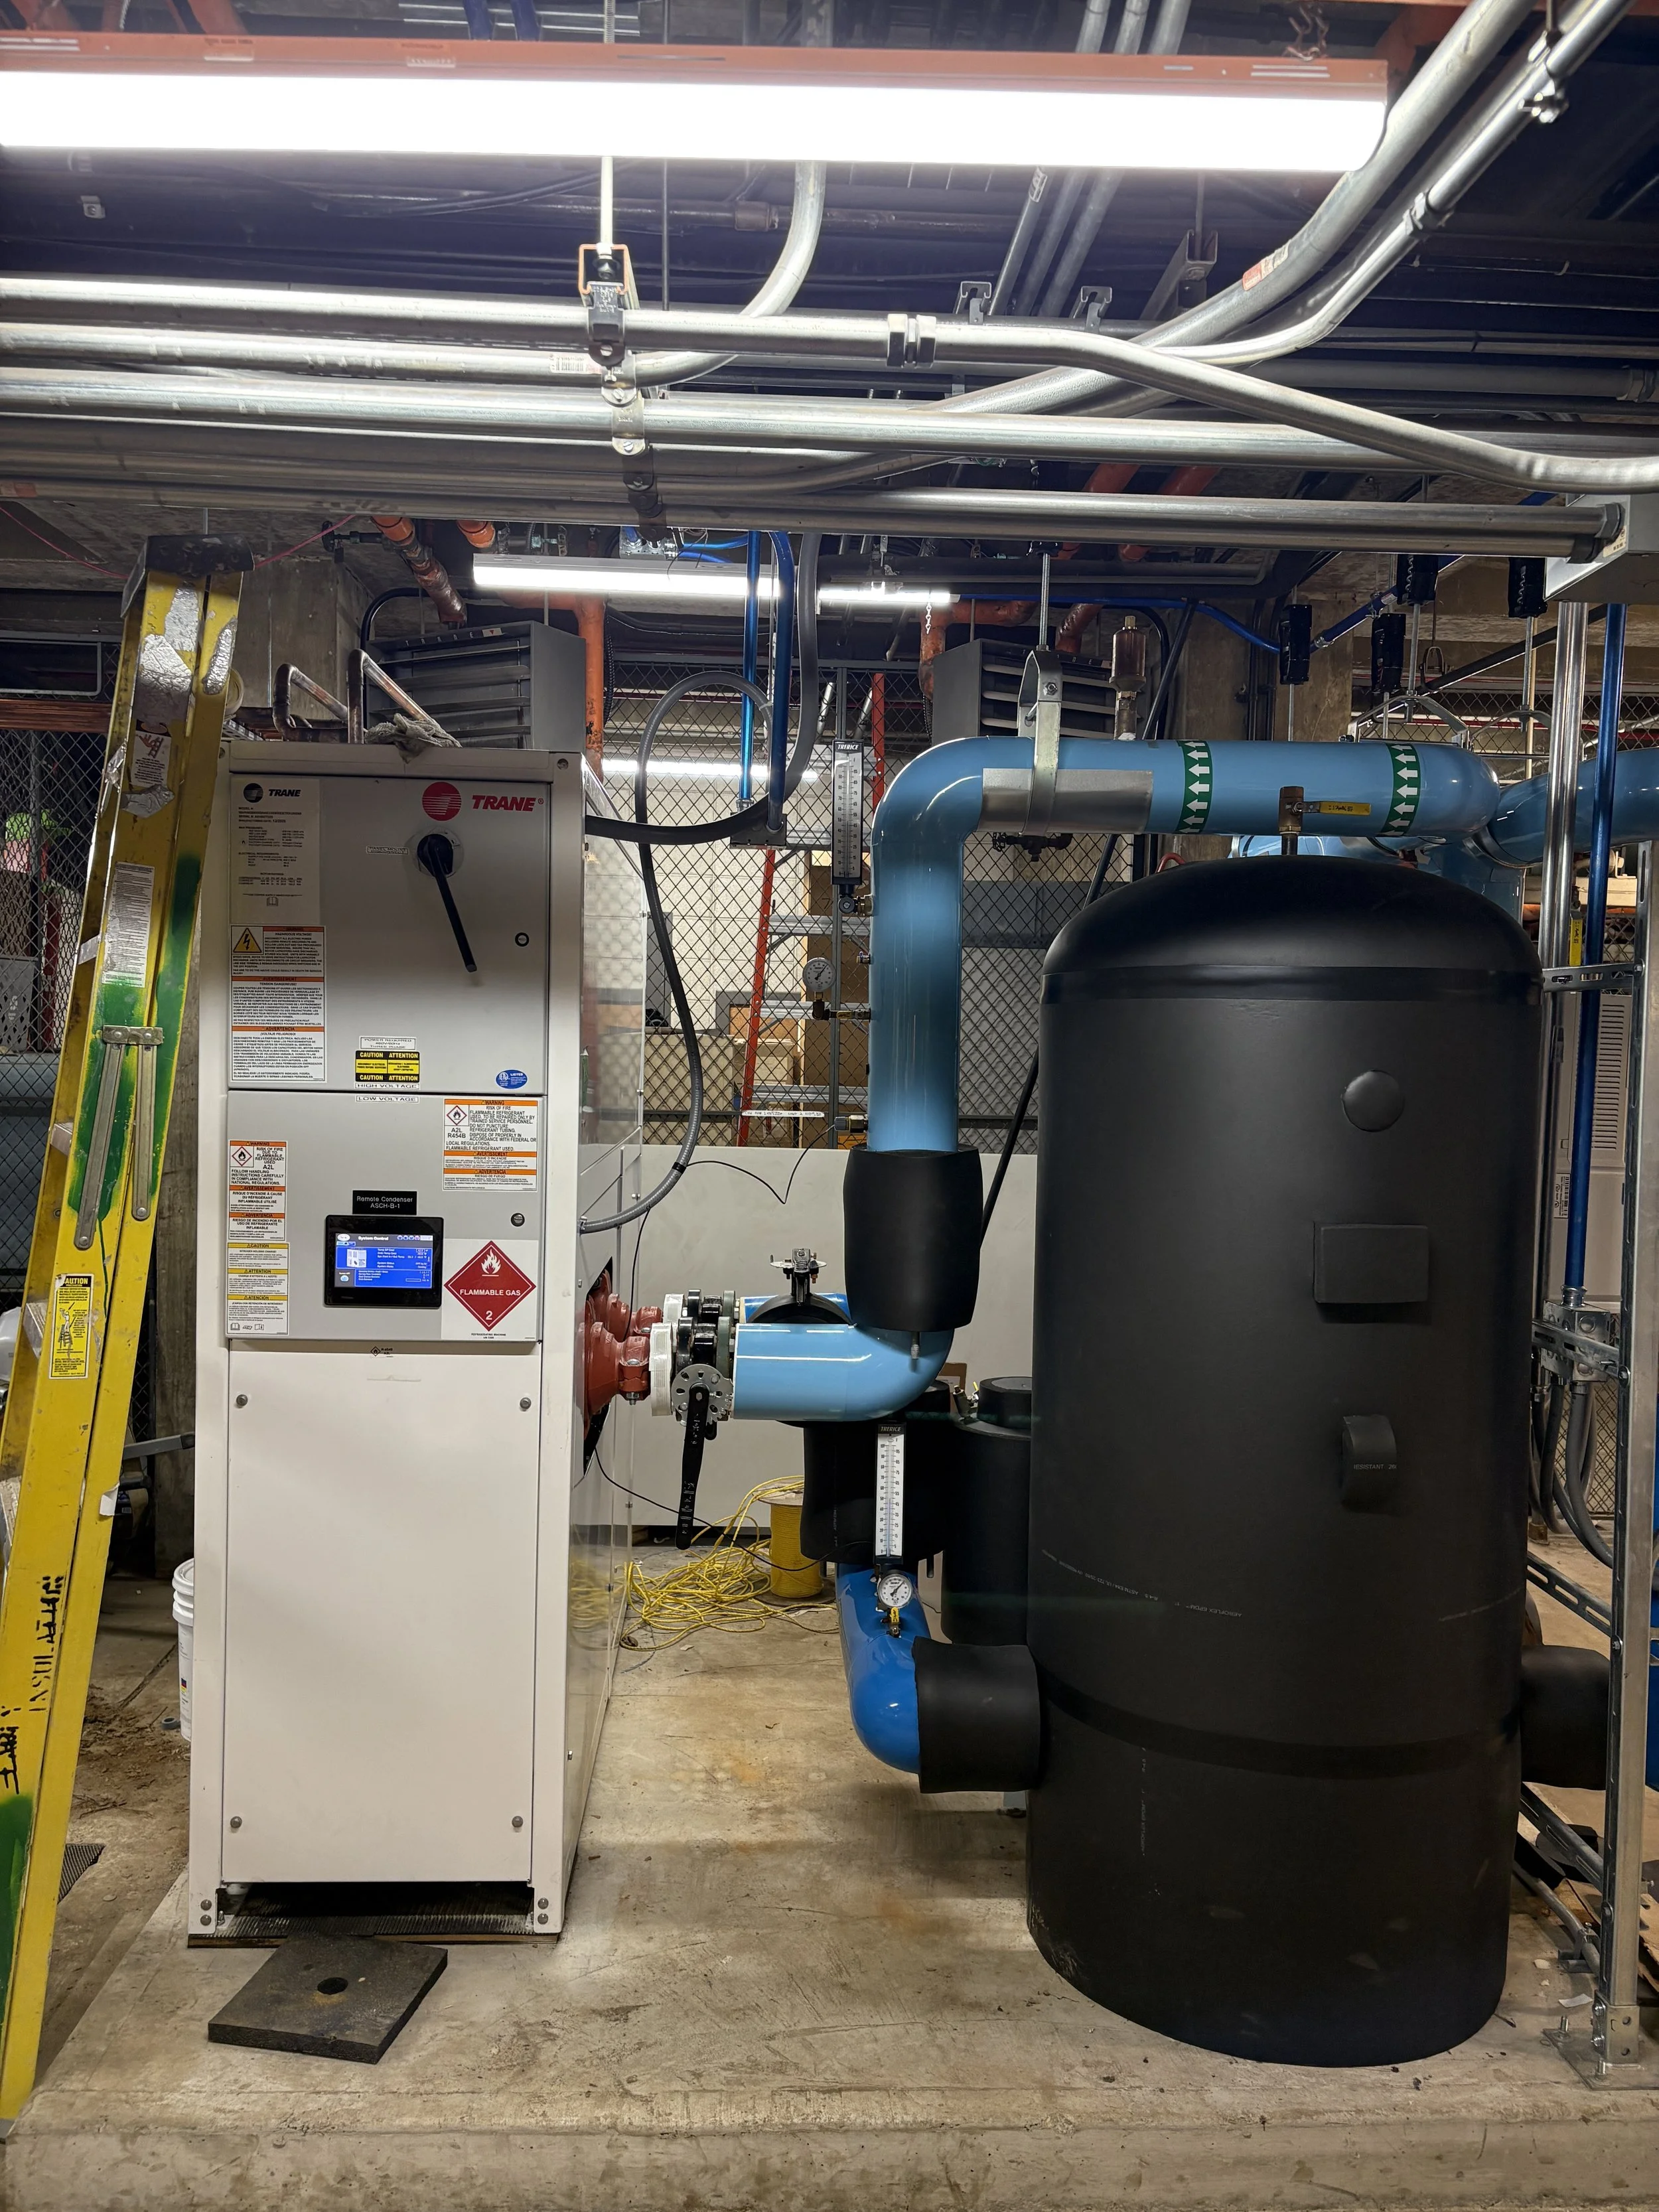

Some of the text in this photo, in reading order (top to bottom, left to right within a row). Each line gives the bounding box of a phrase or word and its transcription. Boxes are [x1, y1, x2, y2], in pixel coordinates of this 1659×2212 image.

[472, 795, 536, 812] TRANE
[486, 1311, 492, 1320] 2
[1209, 1608, 1242, 1617] AEROFLEX
